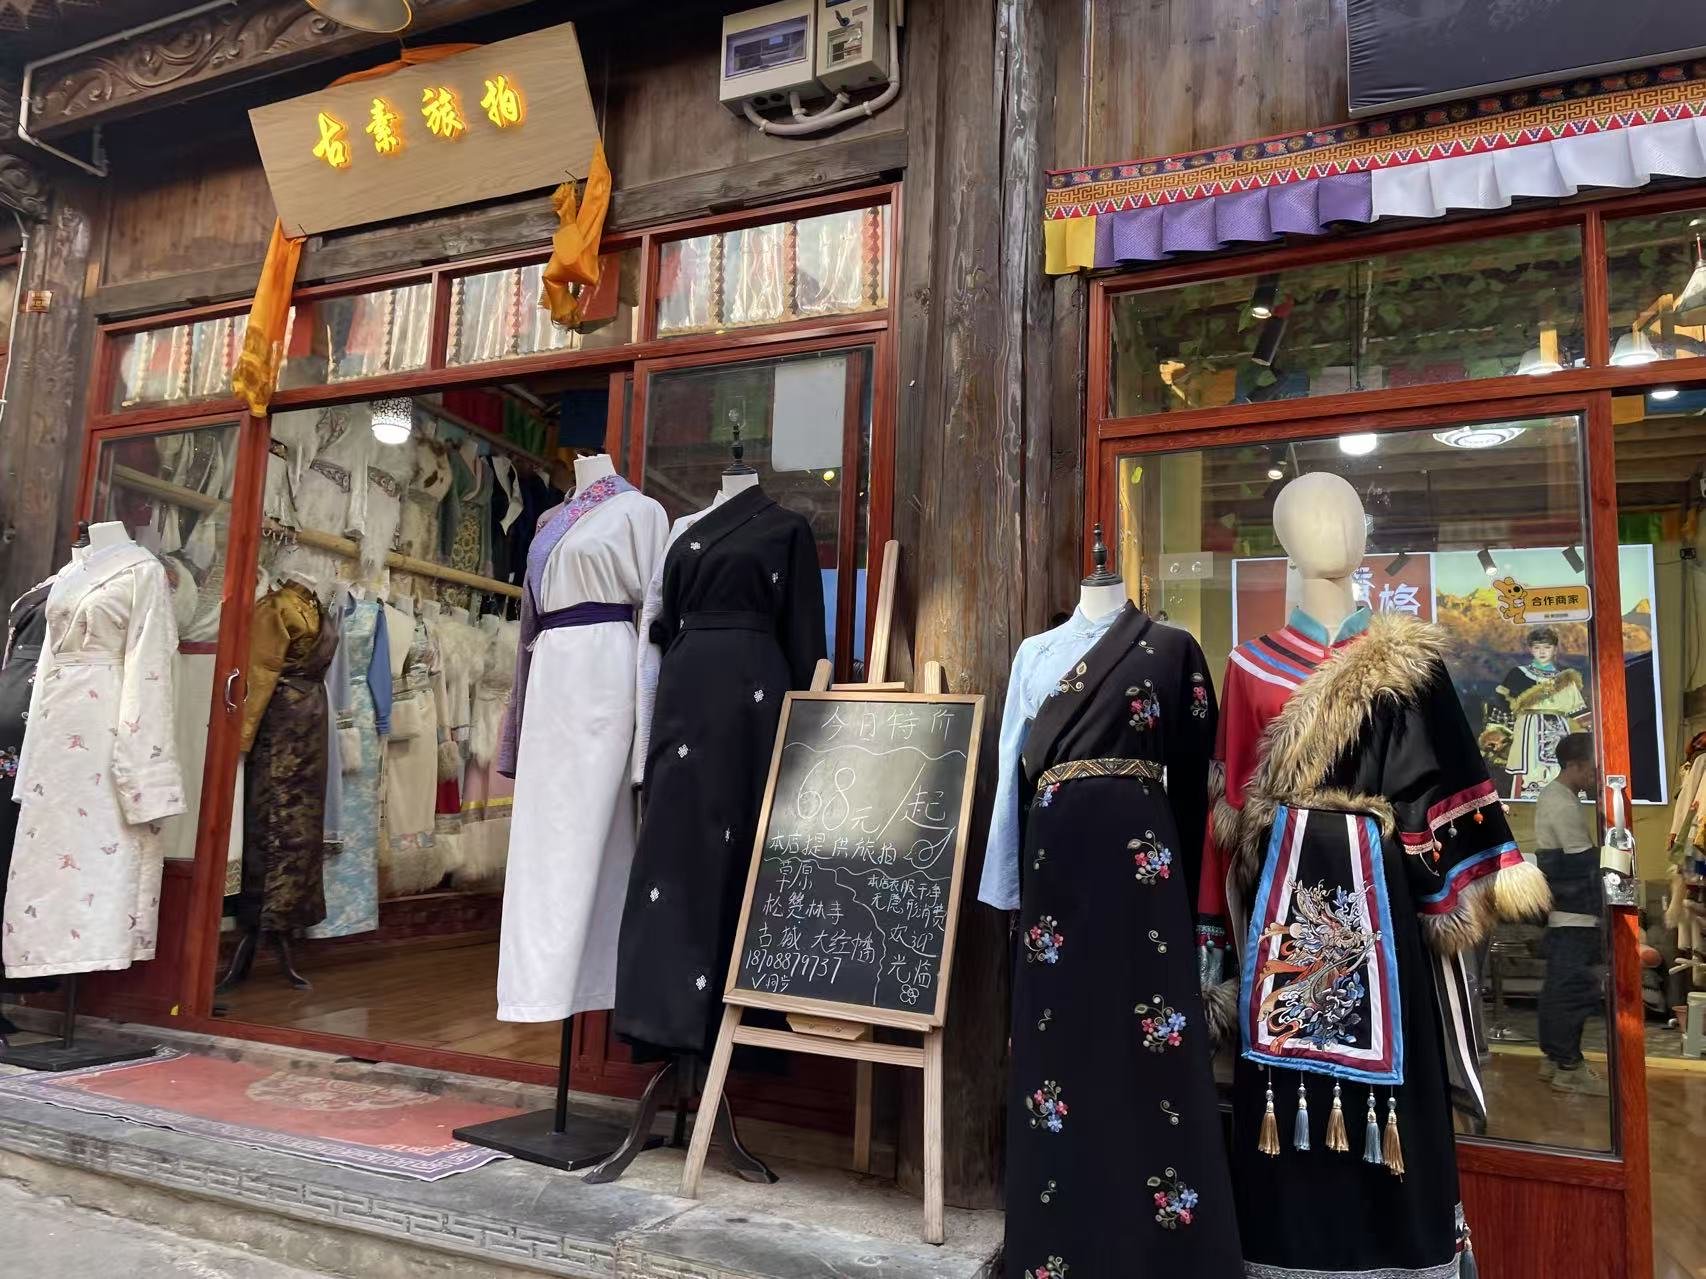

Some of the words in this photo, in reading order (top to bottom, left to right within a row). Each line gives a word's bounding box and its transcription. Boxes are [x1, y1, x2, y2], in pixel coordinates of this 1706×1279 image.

[1531, 594, 1580, 607] 合作商家
[821, 705, 955, 742] 今日特价
[769, 831, 897, 865] 本店提供旅拍
[775, 860, 813, 893] 草原
[867, 874, 941, 908] 本店衣服干净
[870, 892, 948, 932] 无隐形消费
[745, 948, 842, 985] 18708879737
